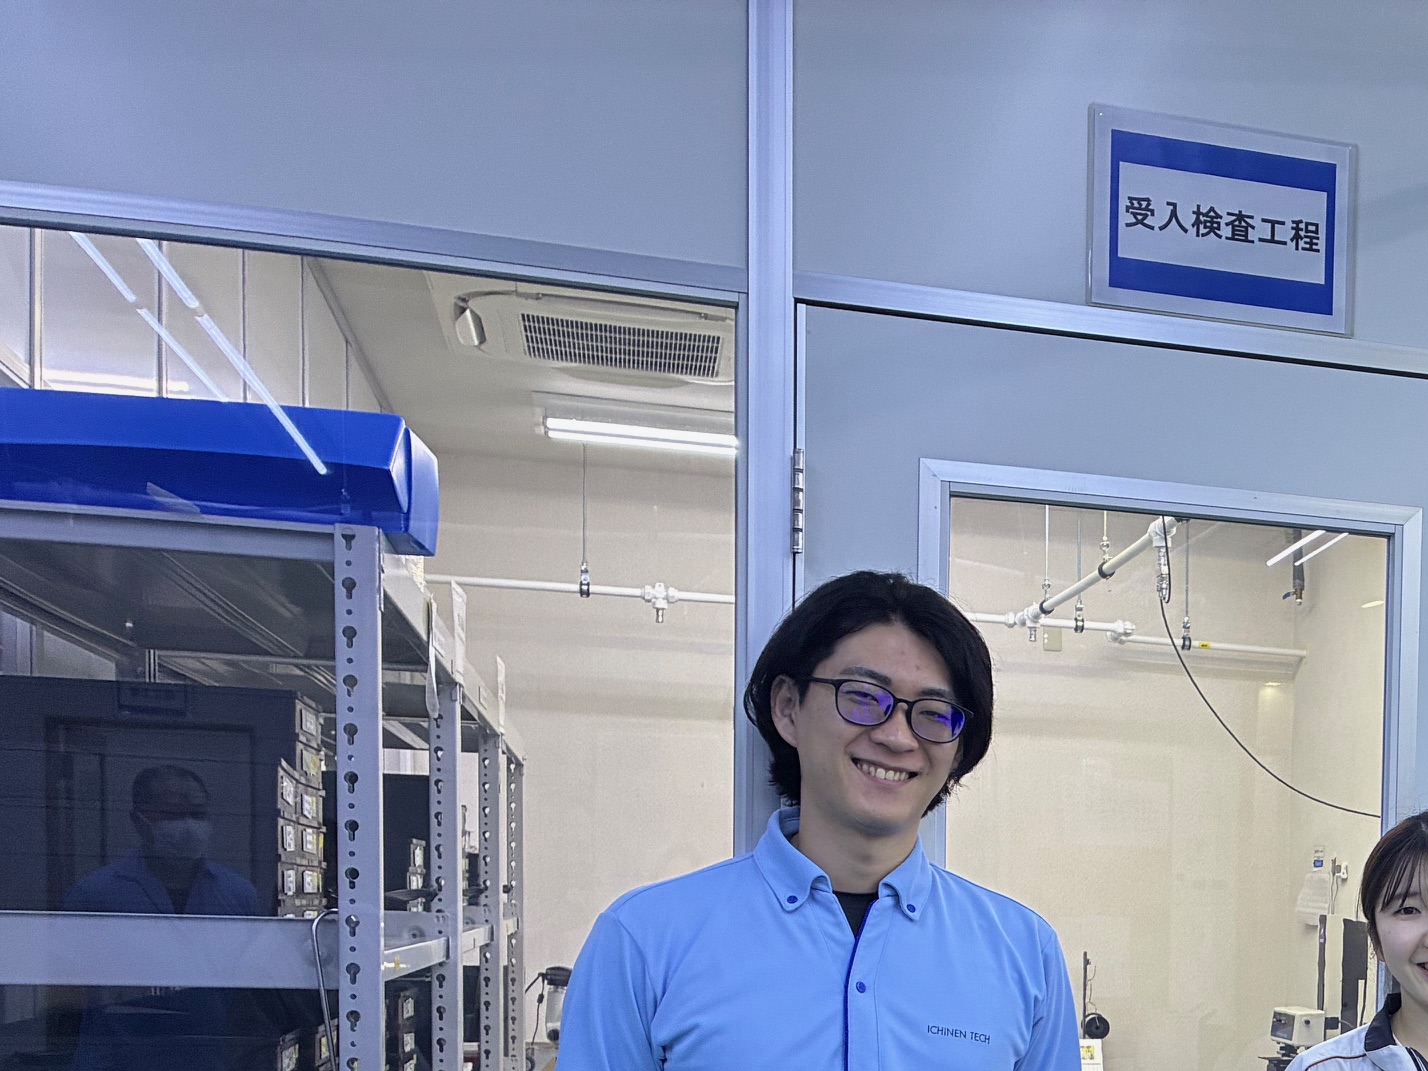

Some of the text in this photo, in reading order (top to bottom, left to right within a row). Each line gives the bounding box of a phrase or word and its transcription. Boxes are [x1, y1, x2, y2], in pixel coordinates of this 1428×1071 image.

[1124, 196, 1321, 254] 受入検査工程
[927, 1025, 991, 1045] ICHINEN TECH
